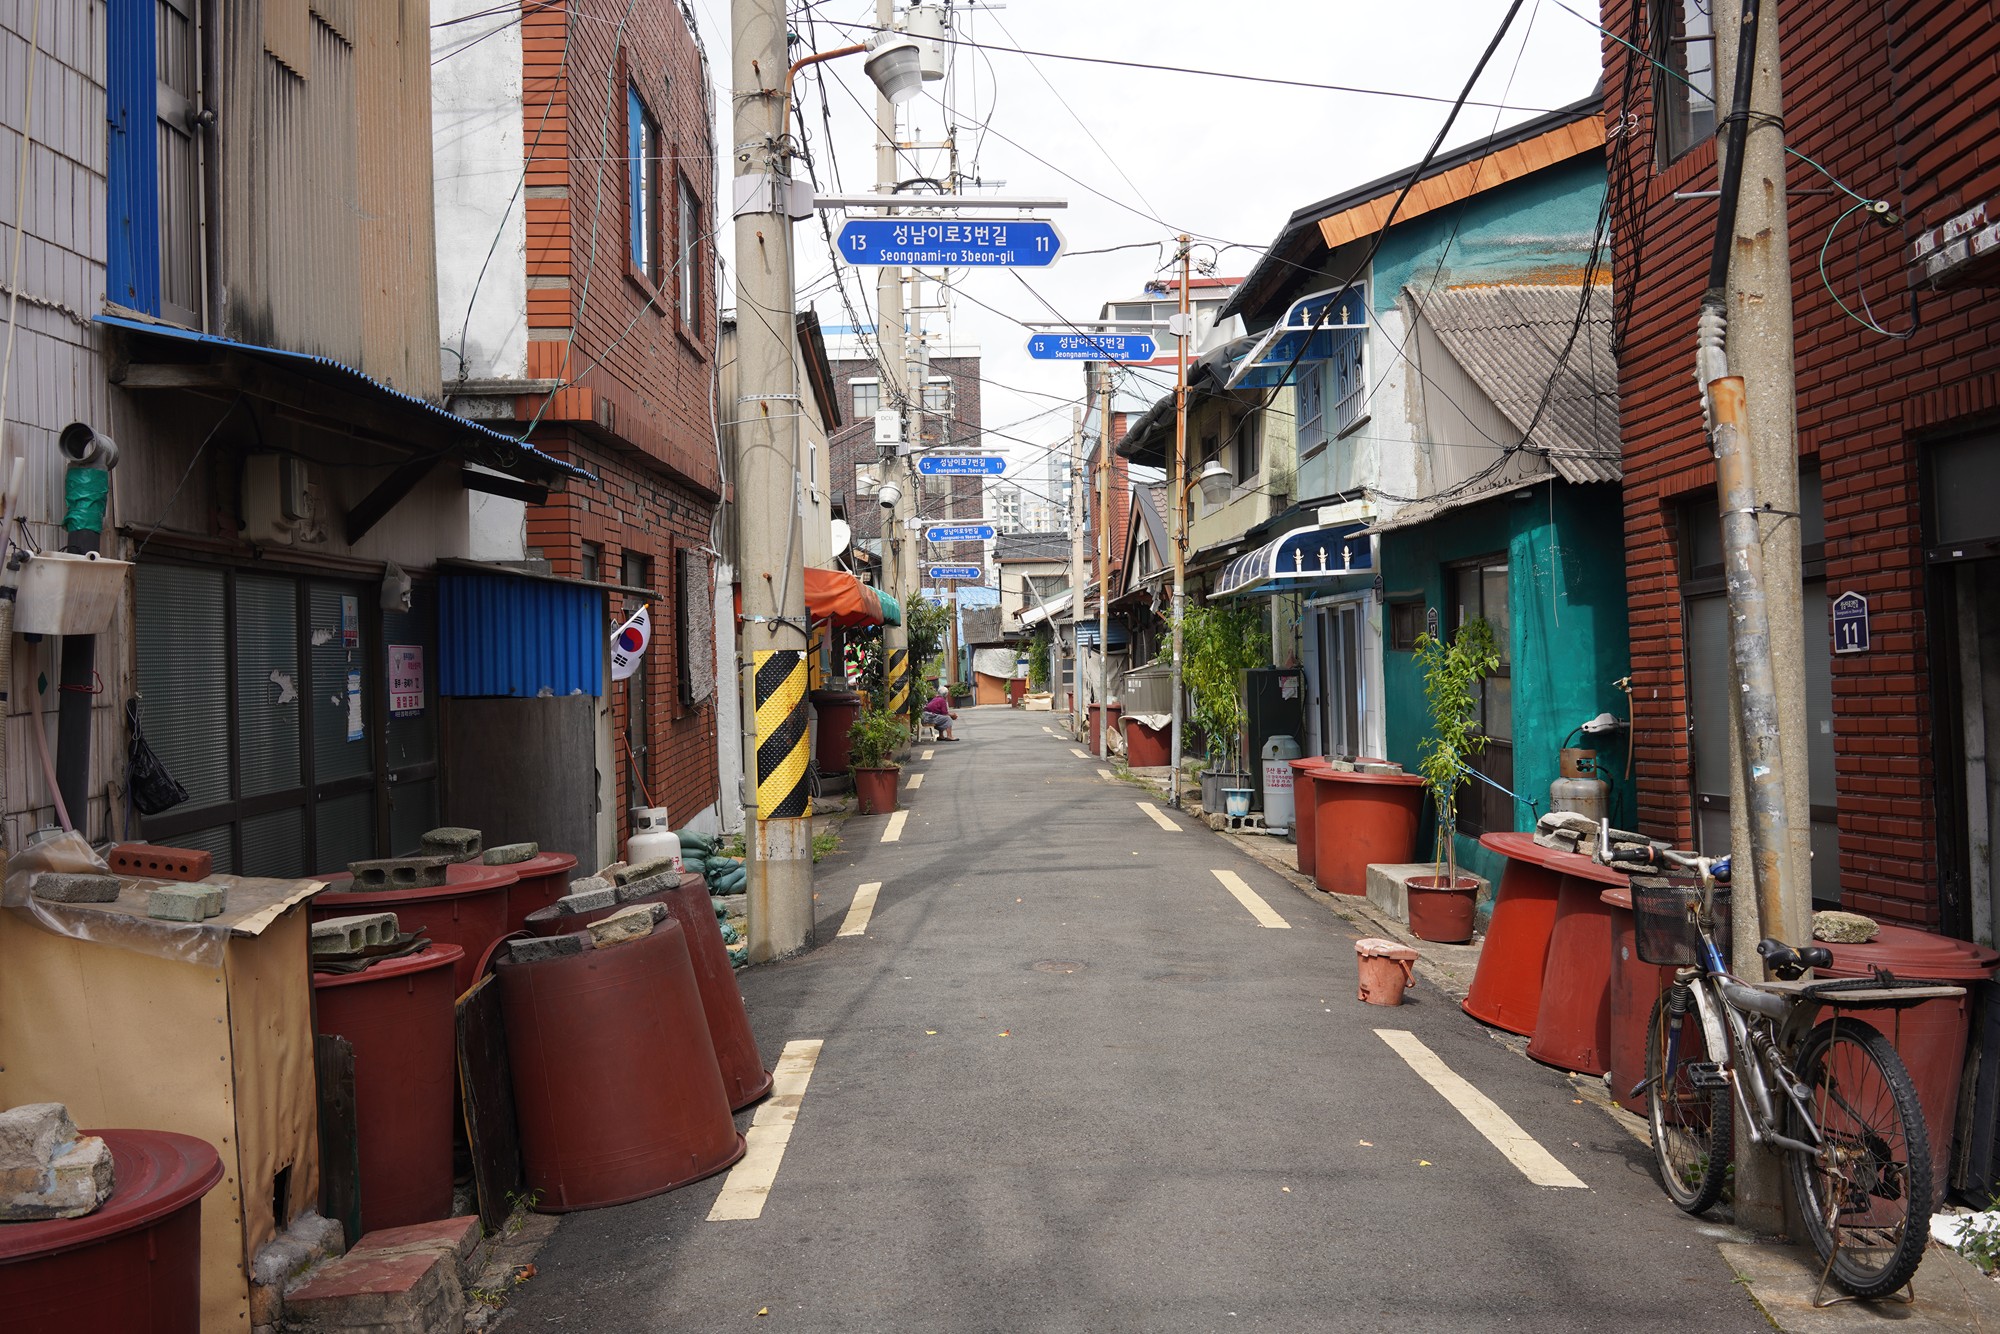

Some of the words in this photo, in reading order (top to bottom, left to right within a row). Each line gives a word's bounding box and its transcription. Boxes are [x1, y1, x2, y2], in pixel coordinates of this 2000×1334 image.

[850, 235, 867, 250] 13
[893, 225, 1007, 247] 성남이로3번길
[1035, 236, 1049, 251] 11
[880, 249, 958, 263] Seongnami-ro
[961, 250, 1015, 264] 3beon-gil
[1034, 342, 1044, 351] 13
[1059, 336, 1125, 349] 성남이로5번길
[1141, 343, 1149, 352] 11
[1055, 350, 1098, 359] Seongnami-ro
[940, 458, 985, 467] 성남이로7번길
[1843, 622, 1858, 644] 11
[396, 695, 419, 709] 출입금지
